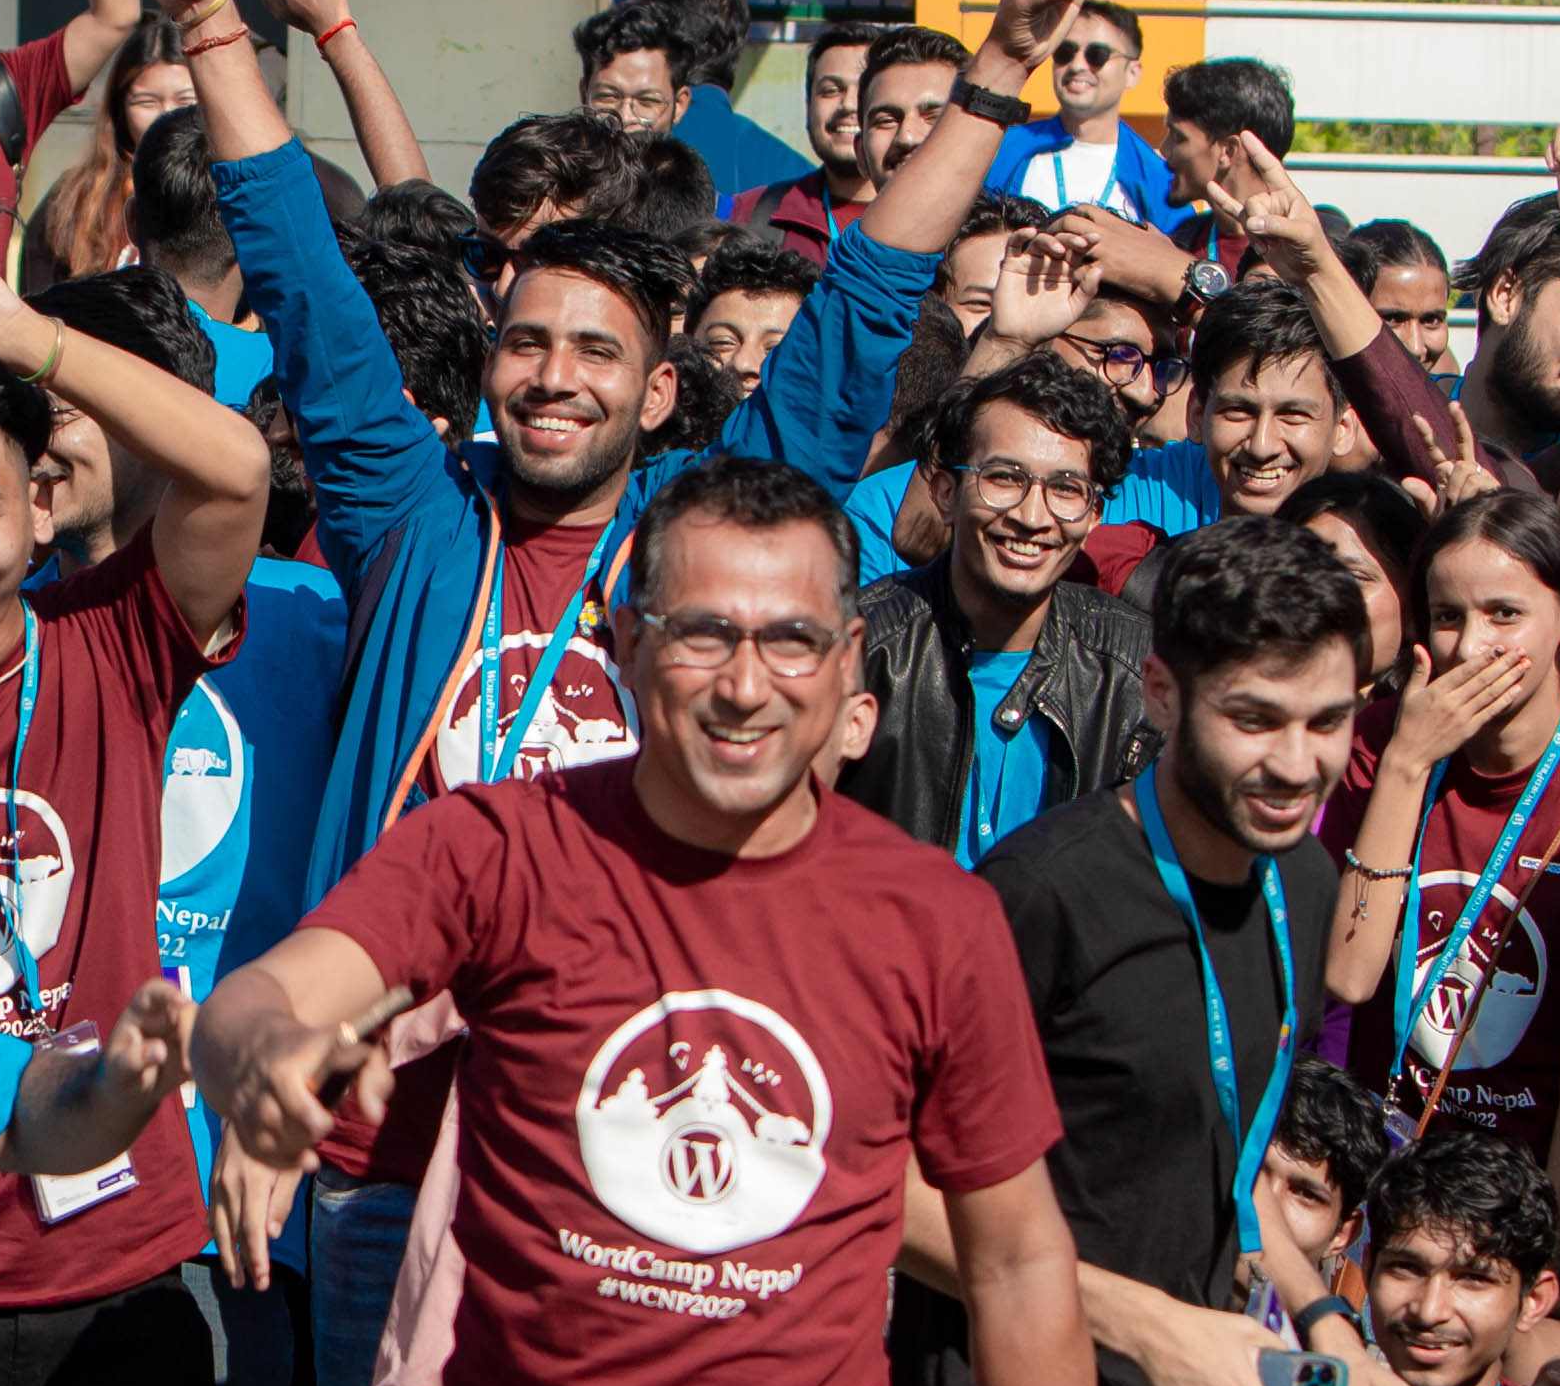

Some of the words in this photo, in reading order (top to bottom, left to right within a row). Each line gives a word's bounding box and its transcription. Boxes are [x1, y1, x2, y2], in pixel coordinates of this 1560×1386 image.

[1476, 1084, 1537, 1112] Nepal
[558, 1228, 716, 1294] WordCamp
[718, 1260, 804, 1300] Nepal
[596, 1276, 748, 1319] #WCNP2022
